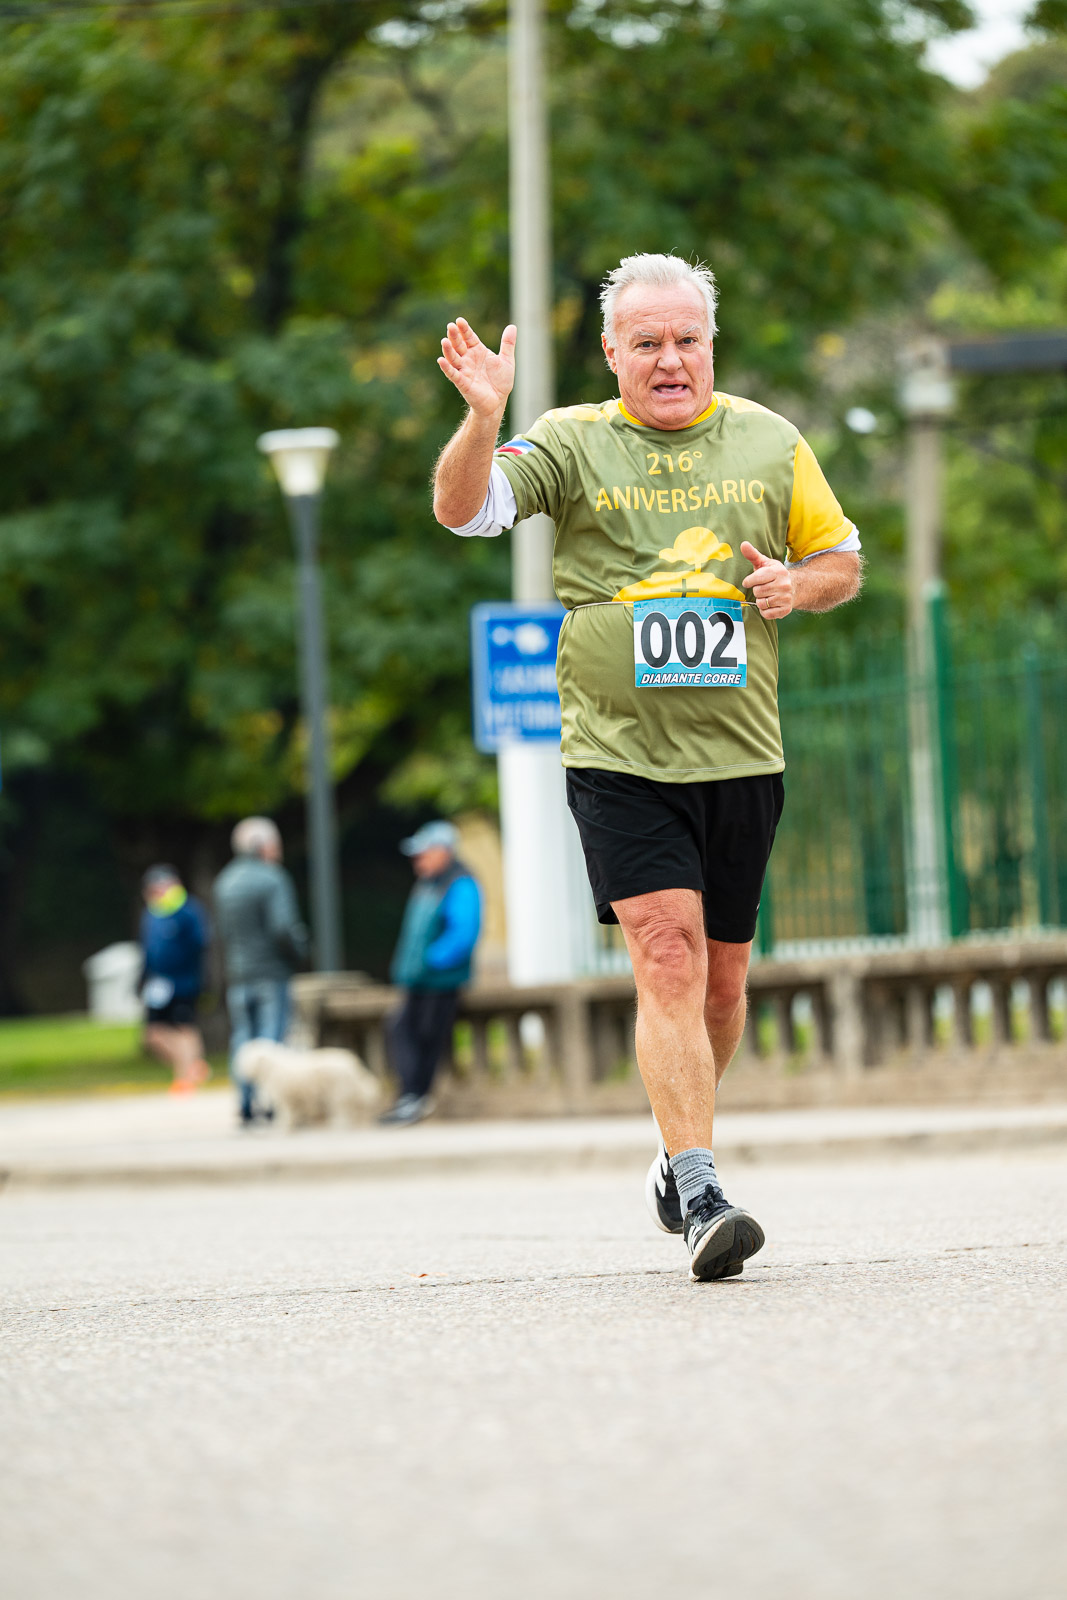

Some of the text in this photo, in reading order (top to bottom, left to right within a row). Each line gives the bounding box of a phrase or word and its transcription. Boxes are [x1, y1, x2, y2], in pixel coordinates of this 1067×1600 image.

[595, 479, 765, 513] ANIVERSARIO
[640, 610, 738, 669] 002
[640, 673, 742, 685] DIAMANTE CORRE
